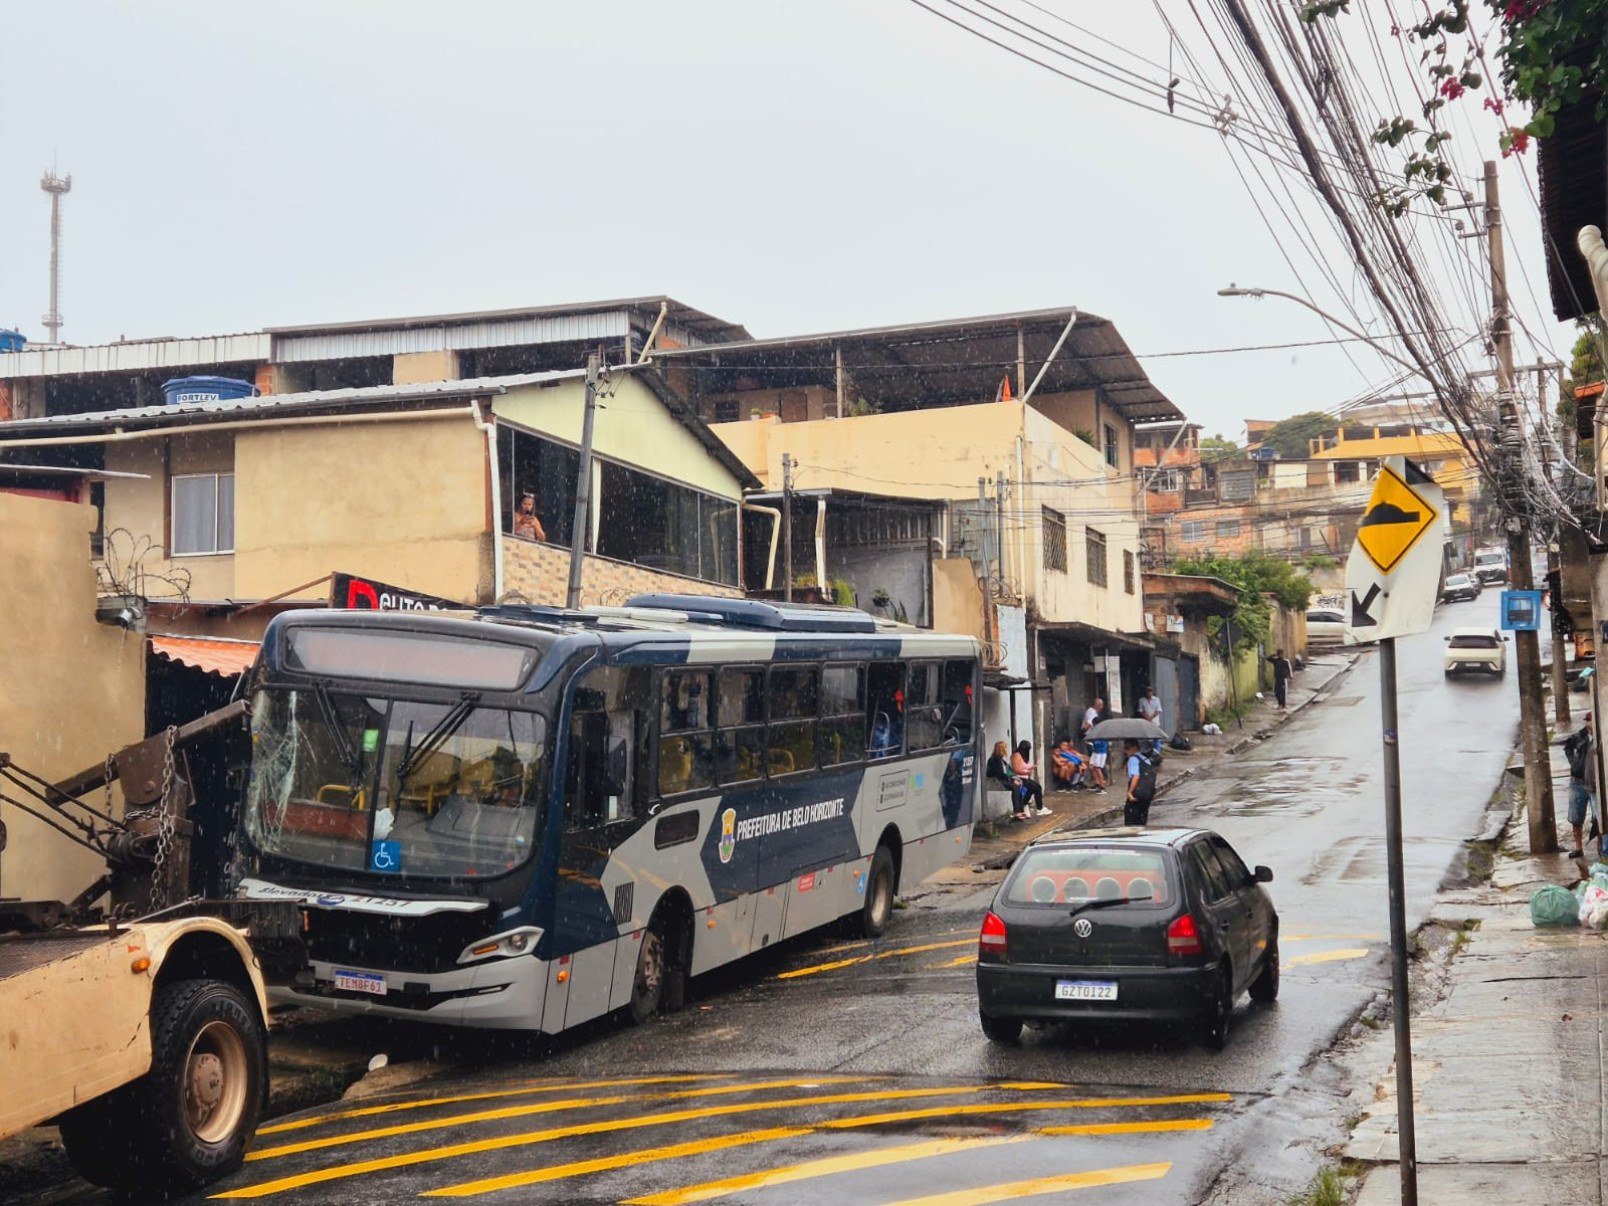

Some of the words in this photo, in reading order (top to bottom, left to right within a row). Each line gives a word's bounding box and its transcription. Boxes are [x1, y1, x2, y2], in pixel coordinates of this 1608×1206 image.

[736, 812, 781, 841] PREFEITURA
[781, 809, 793, 831] DE
[792, 805, 810, 828] BELO
[809, 798, 844, 823] HORIZONTE
[1061, 985, 1112, 998] GZT0122
